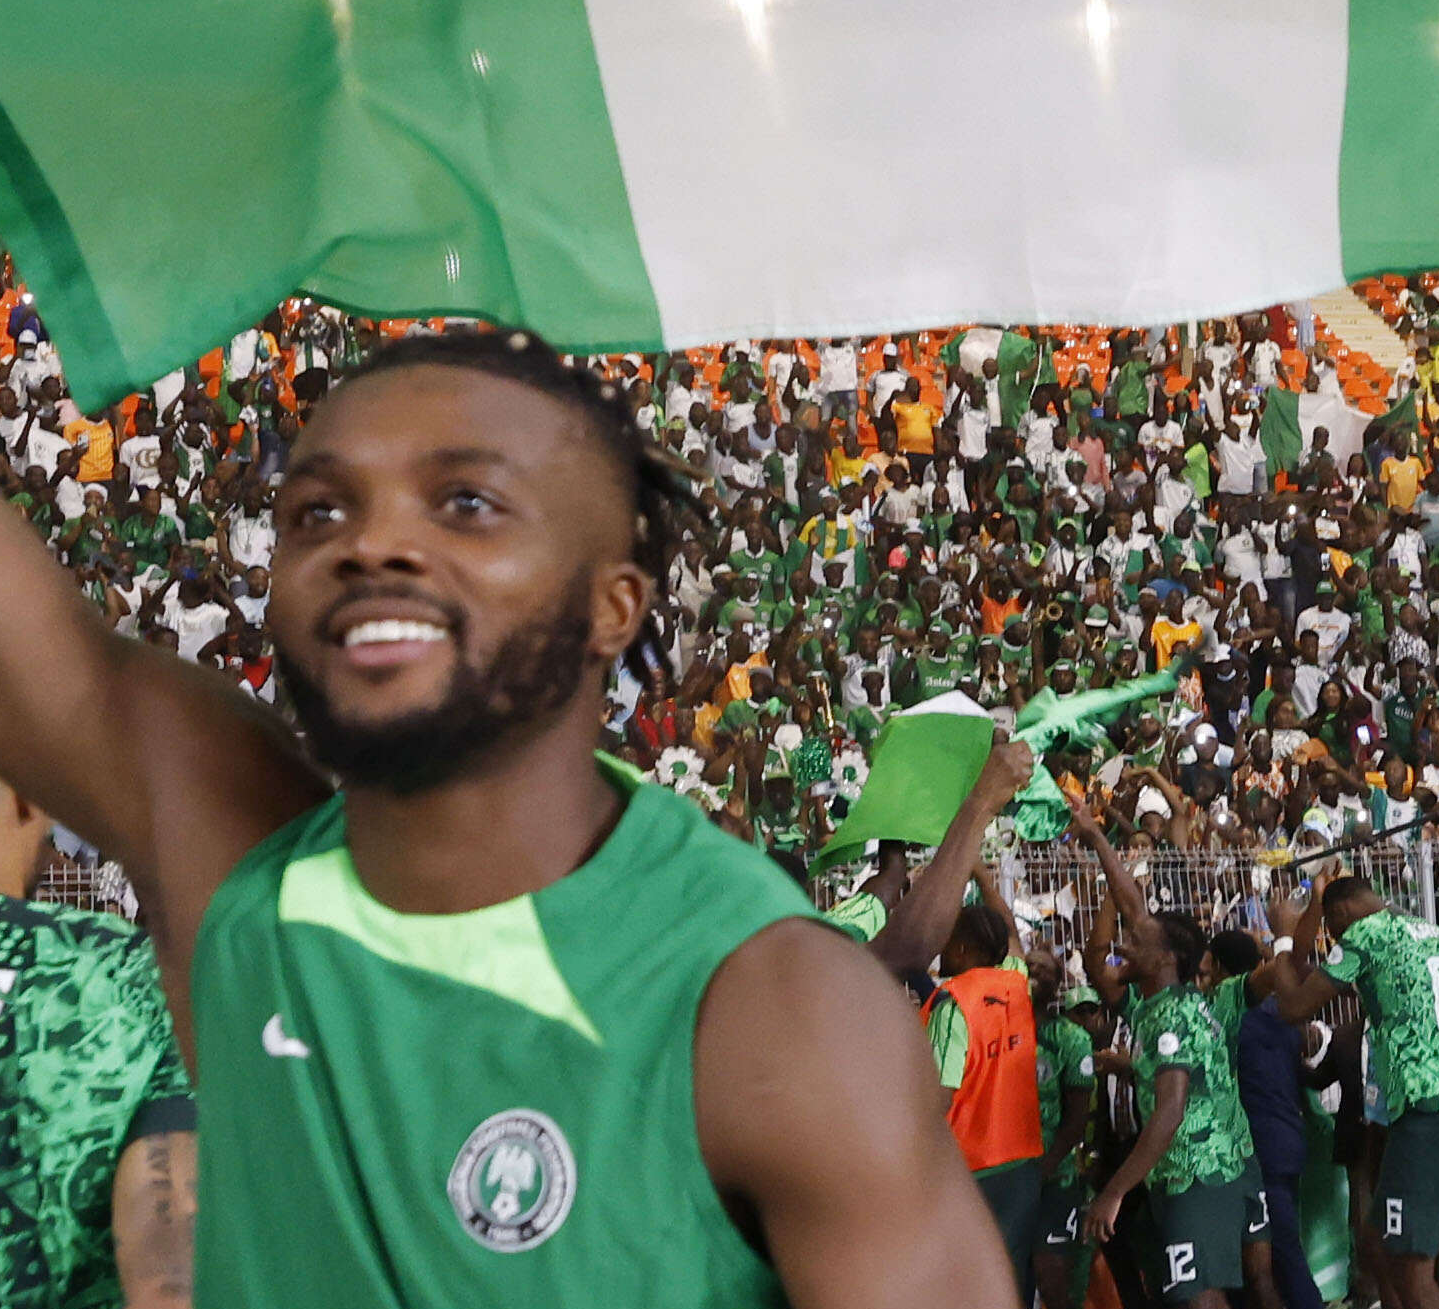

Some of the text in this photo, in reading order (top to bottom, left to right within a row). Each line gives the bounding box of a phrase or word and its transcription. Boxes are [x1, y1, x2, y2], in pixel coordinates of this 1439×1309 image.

[1066, 1207, 1077, 1241] 4
[1386, 1198, 1402, 1236] 6
[1165, 1242, 1197, 1284] 12
